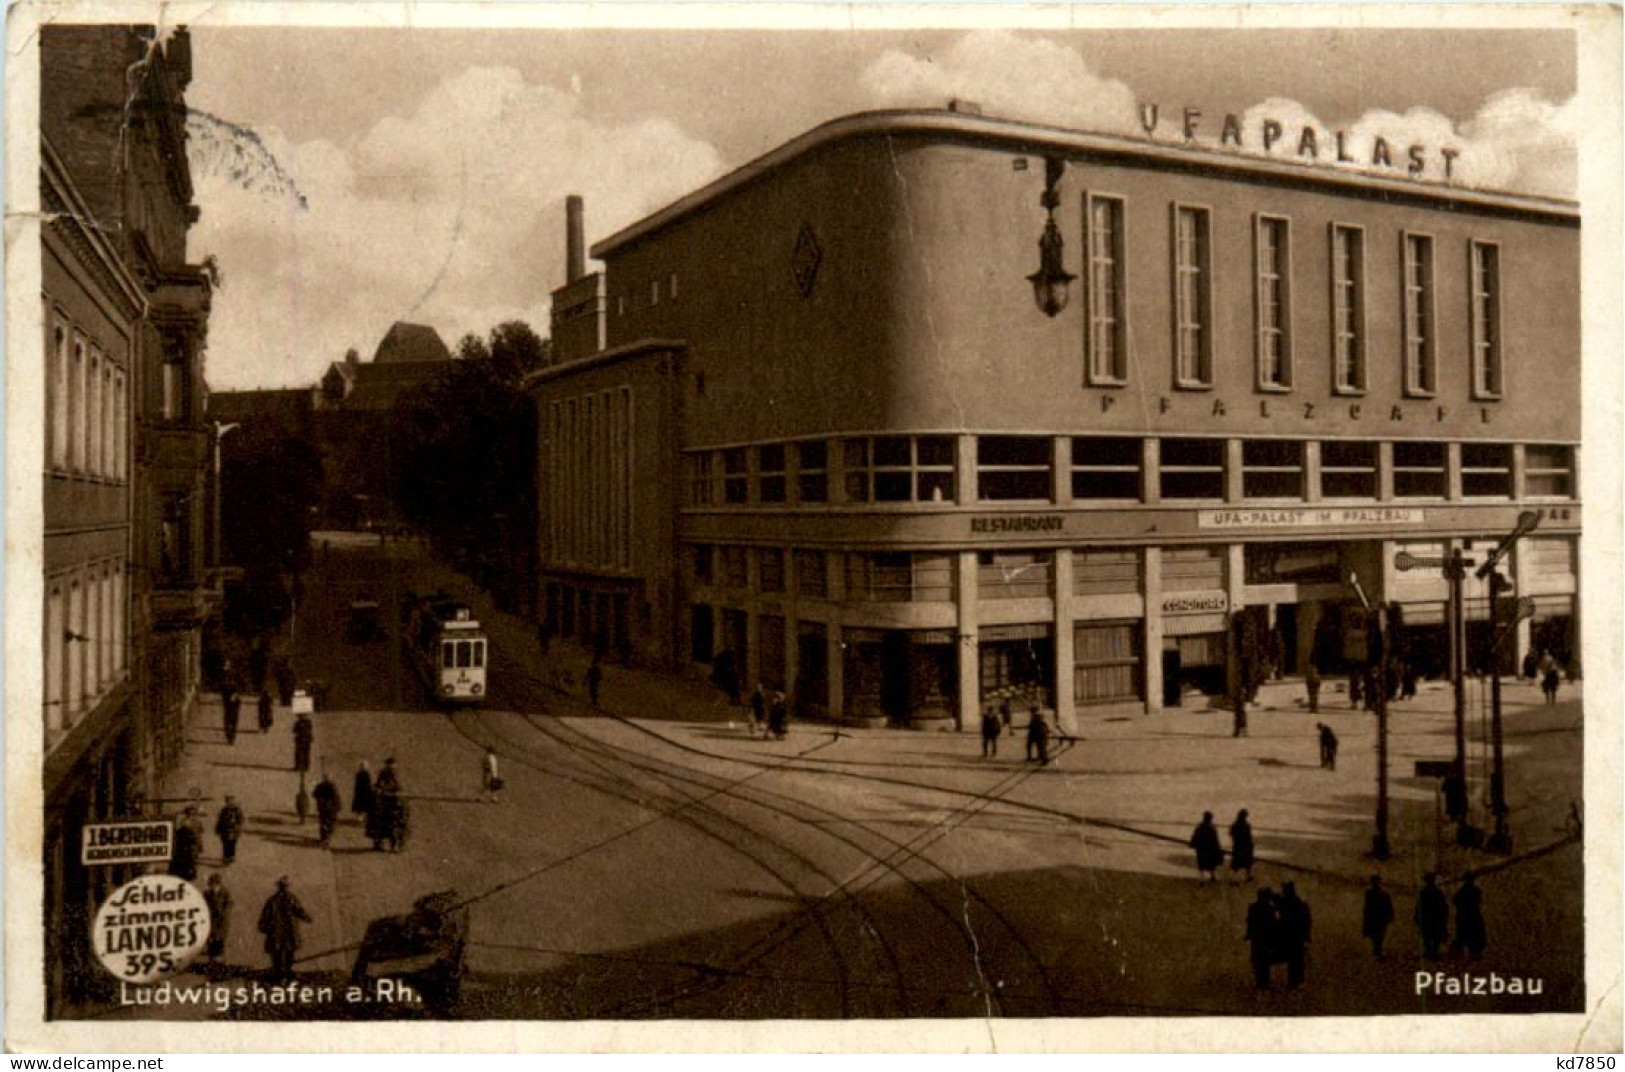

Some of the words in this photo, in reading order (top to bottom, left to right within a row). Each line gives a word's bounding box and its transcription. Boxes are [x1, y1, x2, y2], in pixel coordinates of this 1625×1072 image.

[1214, 511, 1305, 525] UFA-PALAST
[1316, 511, 1331, 523] IM
[1342, 510, 1410, 523] PFALZBAU
[103, 909, 200, 928] zimmer
[106, 922, 198, 955] LANDES
